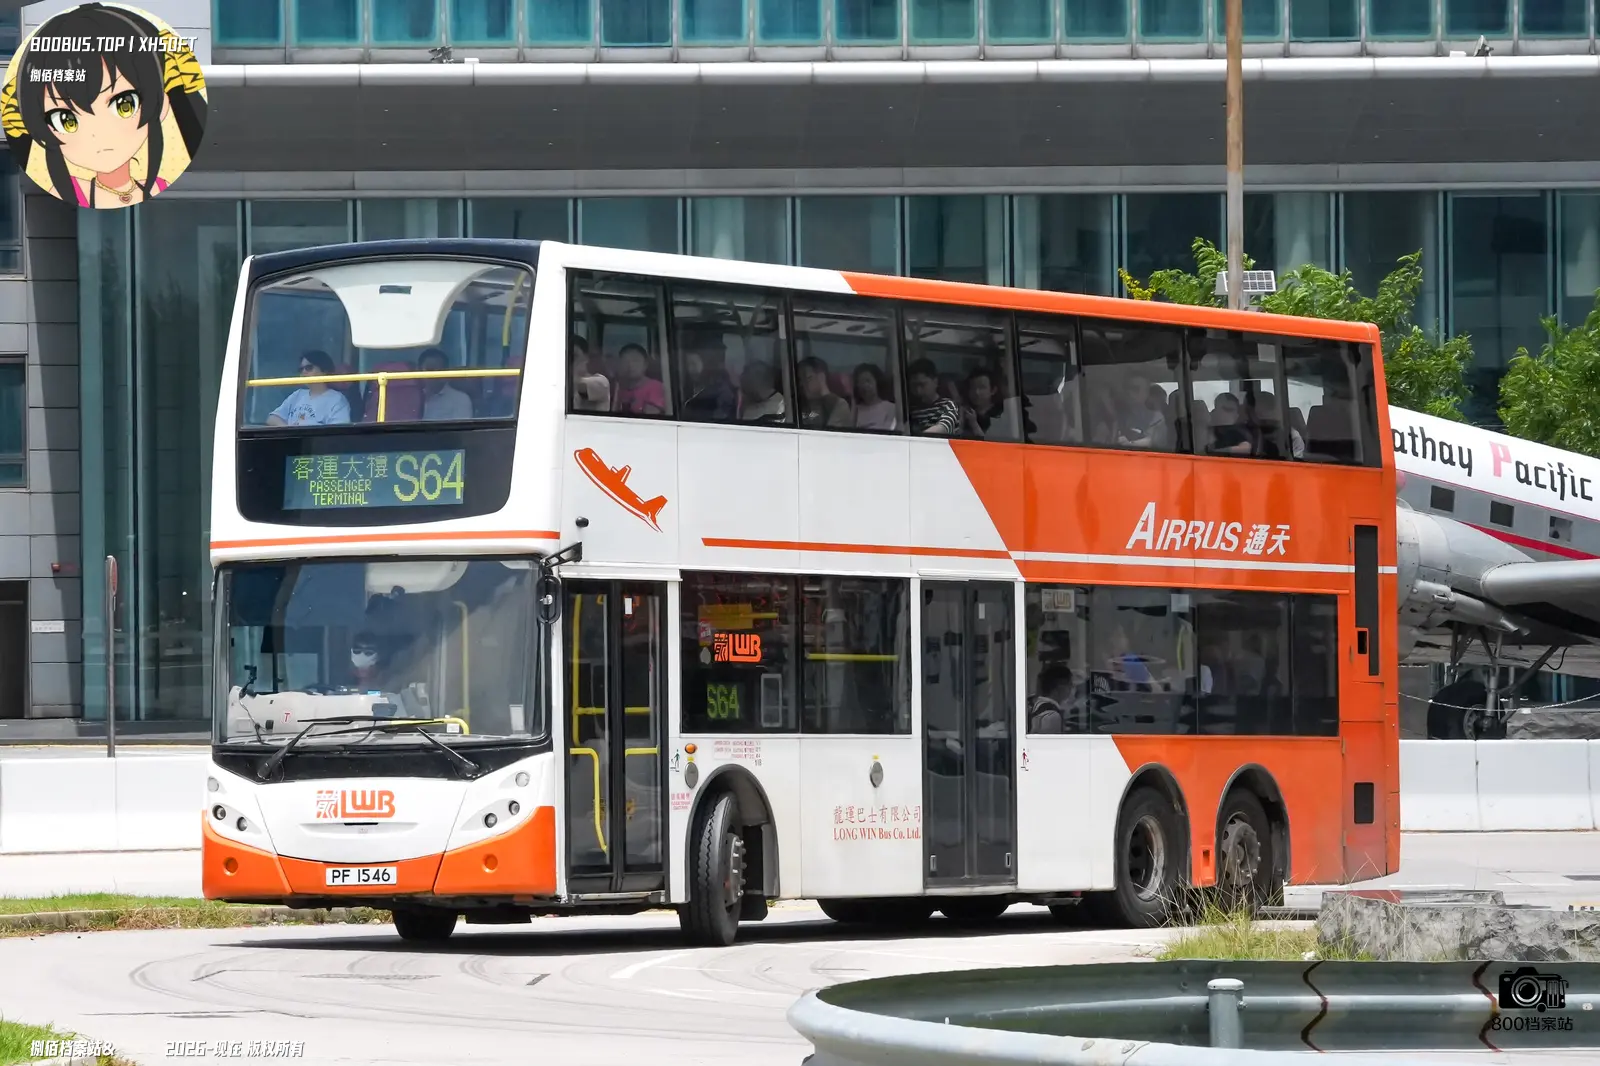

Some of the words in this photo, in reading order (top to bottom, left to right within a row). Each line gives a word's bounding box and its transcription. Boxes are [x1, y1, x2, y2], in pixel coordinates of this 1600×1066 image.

[292, 455, 388, 480] 客運大樓
[394, 452, 464, 502] S64
[1489, 441, 1593, 501] Pacific
[309, 479, 372, 493] PASSENGER
[312, 492, 369, 506] TERMINAL
[1242, 523, 1291, 556] 通天
[728, 633, 762, 662] LWB
[706, 685, 740, 719] S64
[340, 789, 396, 818] LWB
[833, 804, 921, 824] 龍運巴士有限公司
[833, 827, 858, 841] LONG
[859, 827, 877, 840] WIN
[878, 827, 892, 840] Bus
[893, 827, 906, 840] Co.
[906, 827, 921, 840] Ltd.
[331, 869, 351, 883] PF
[357, 868, 391, 883] 1546
